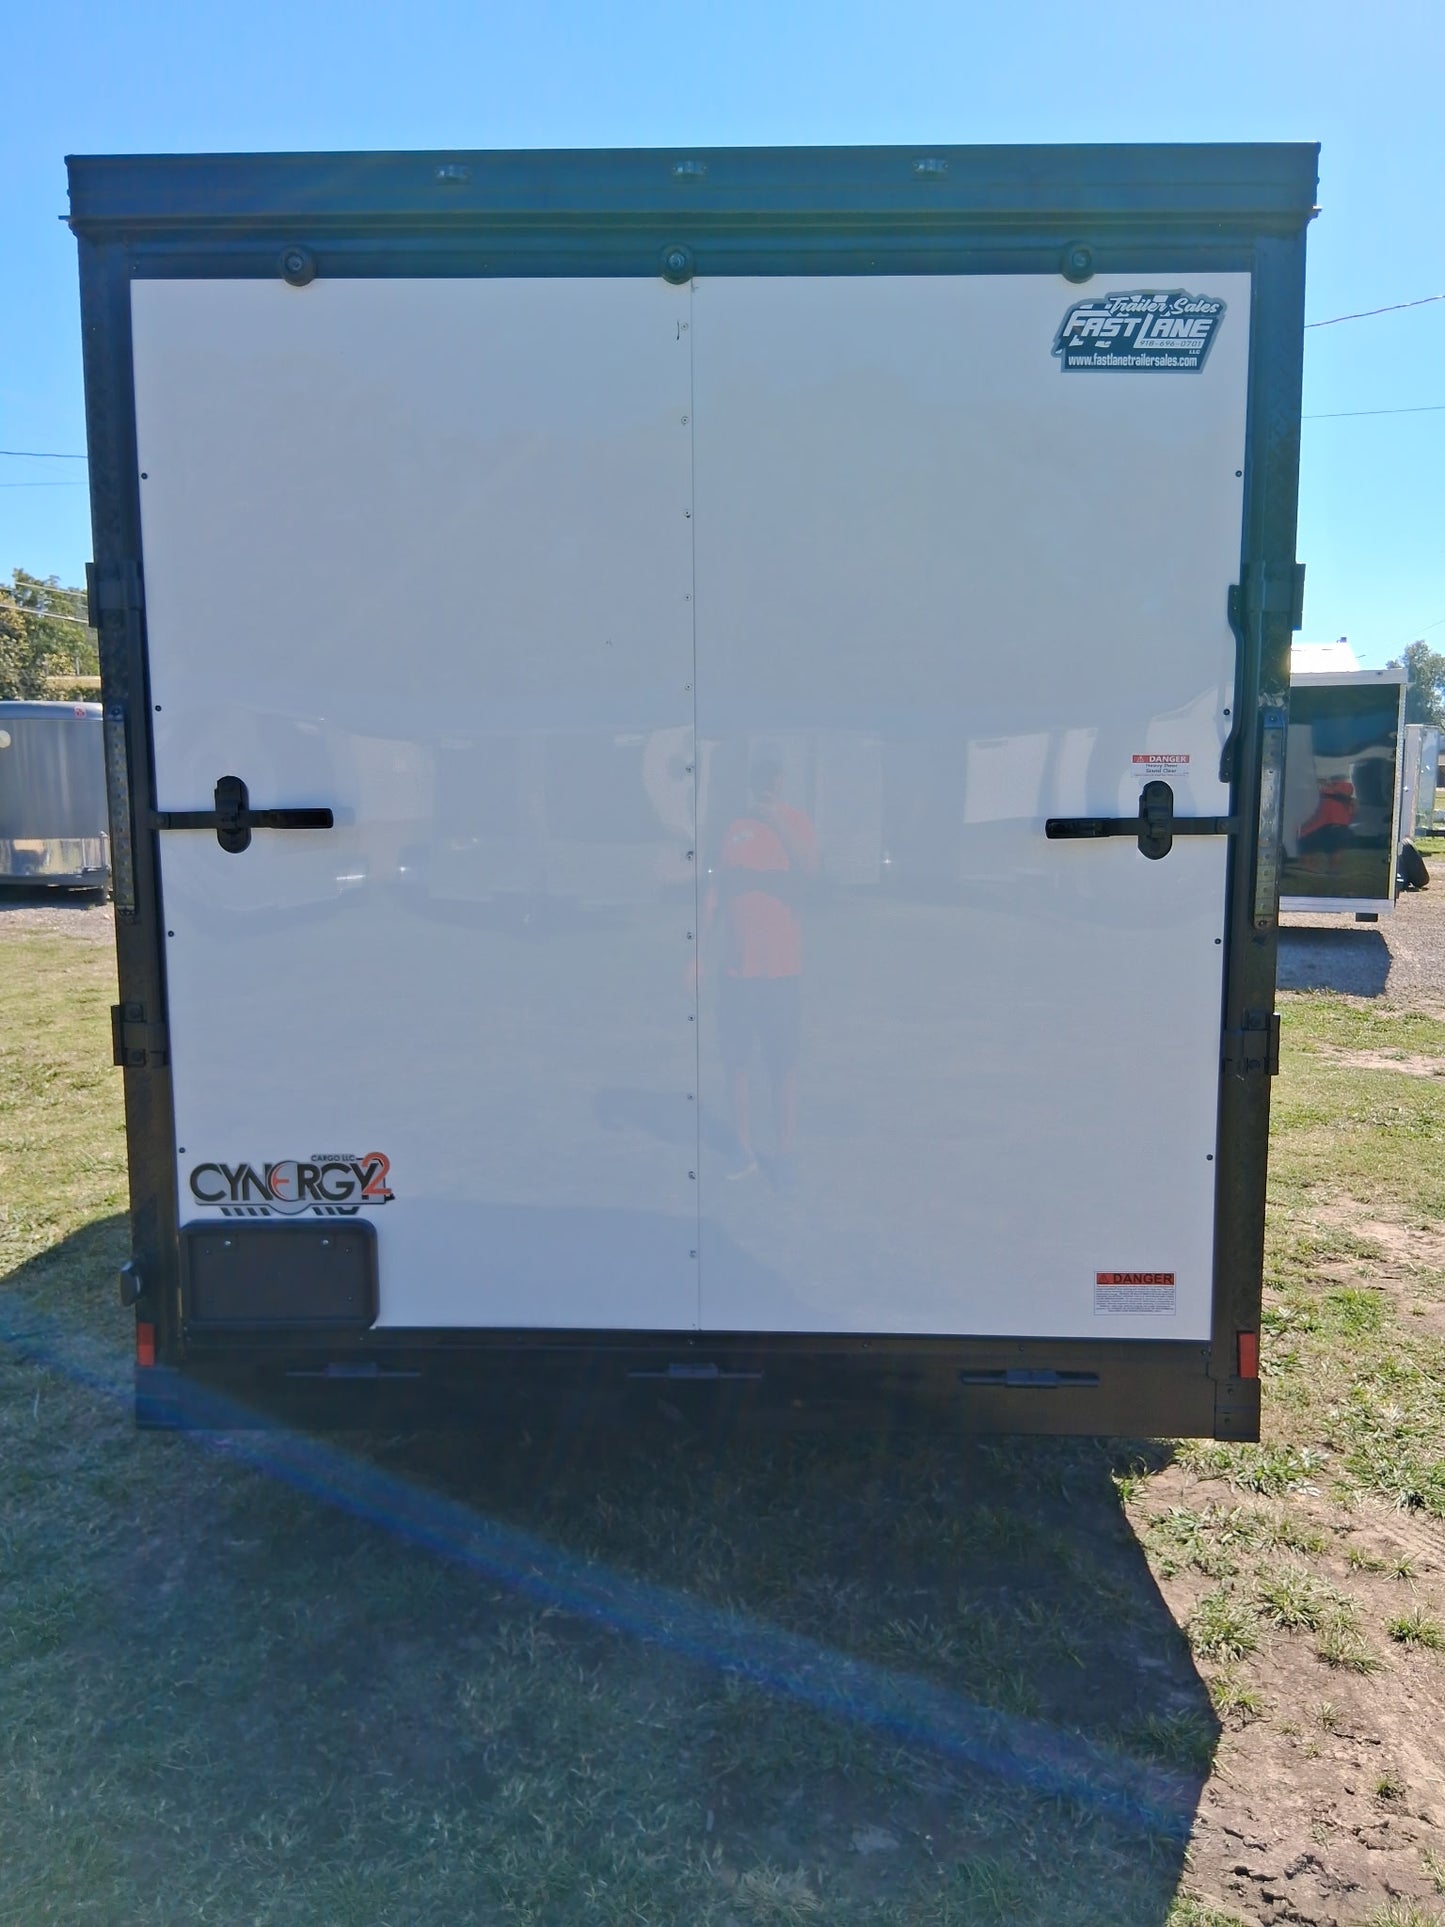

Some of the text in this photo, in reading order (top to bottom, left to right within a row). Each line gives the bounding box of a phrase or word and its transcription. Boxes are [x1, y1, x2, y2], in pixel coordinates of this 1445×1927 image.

[1110, 297, 1220, 315] Trailer Sales
[1068, 353, 1198, 367] www.fastlanetrailersales.com
[311, 1154, 356, 1162] CARGO LLC
[1113, 1273, 1173, 1285] DANGER
